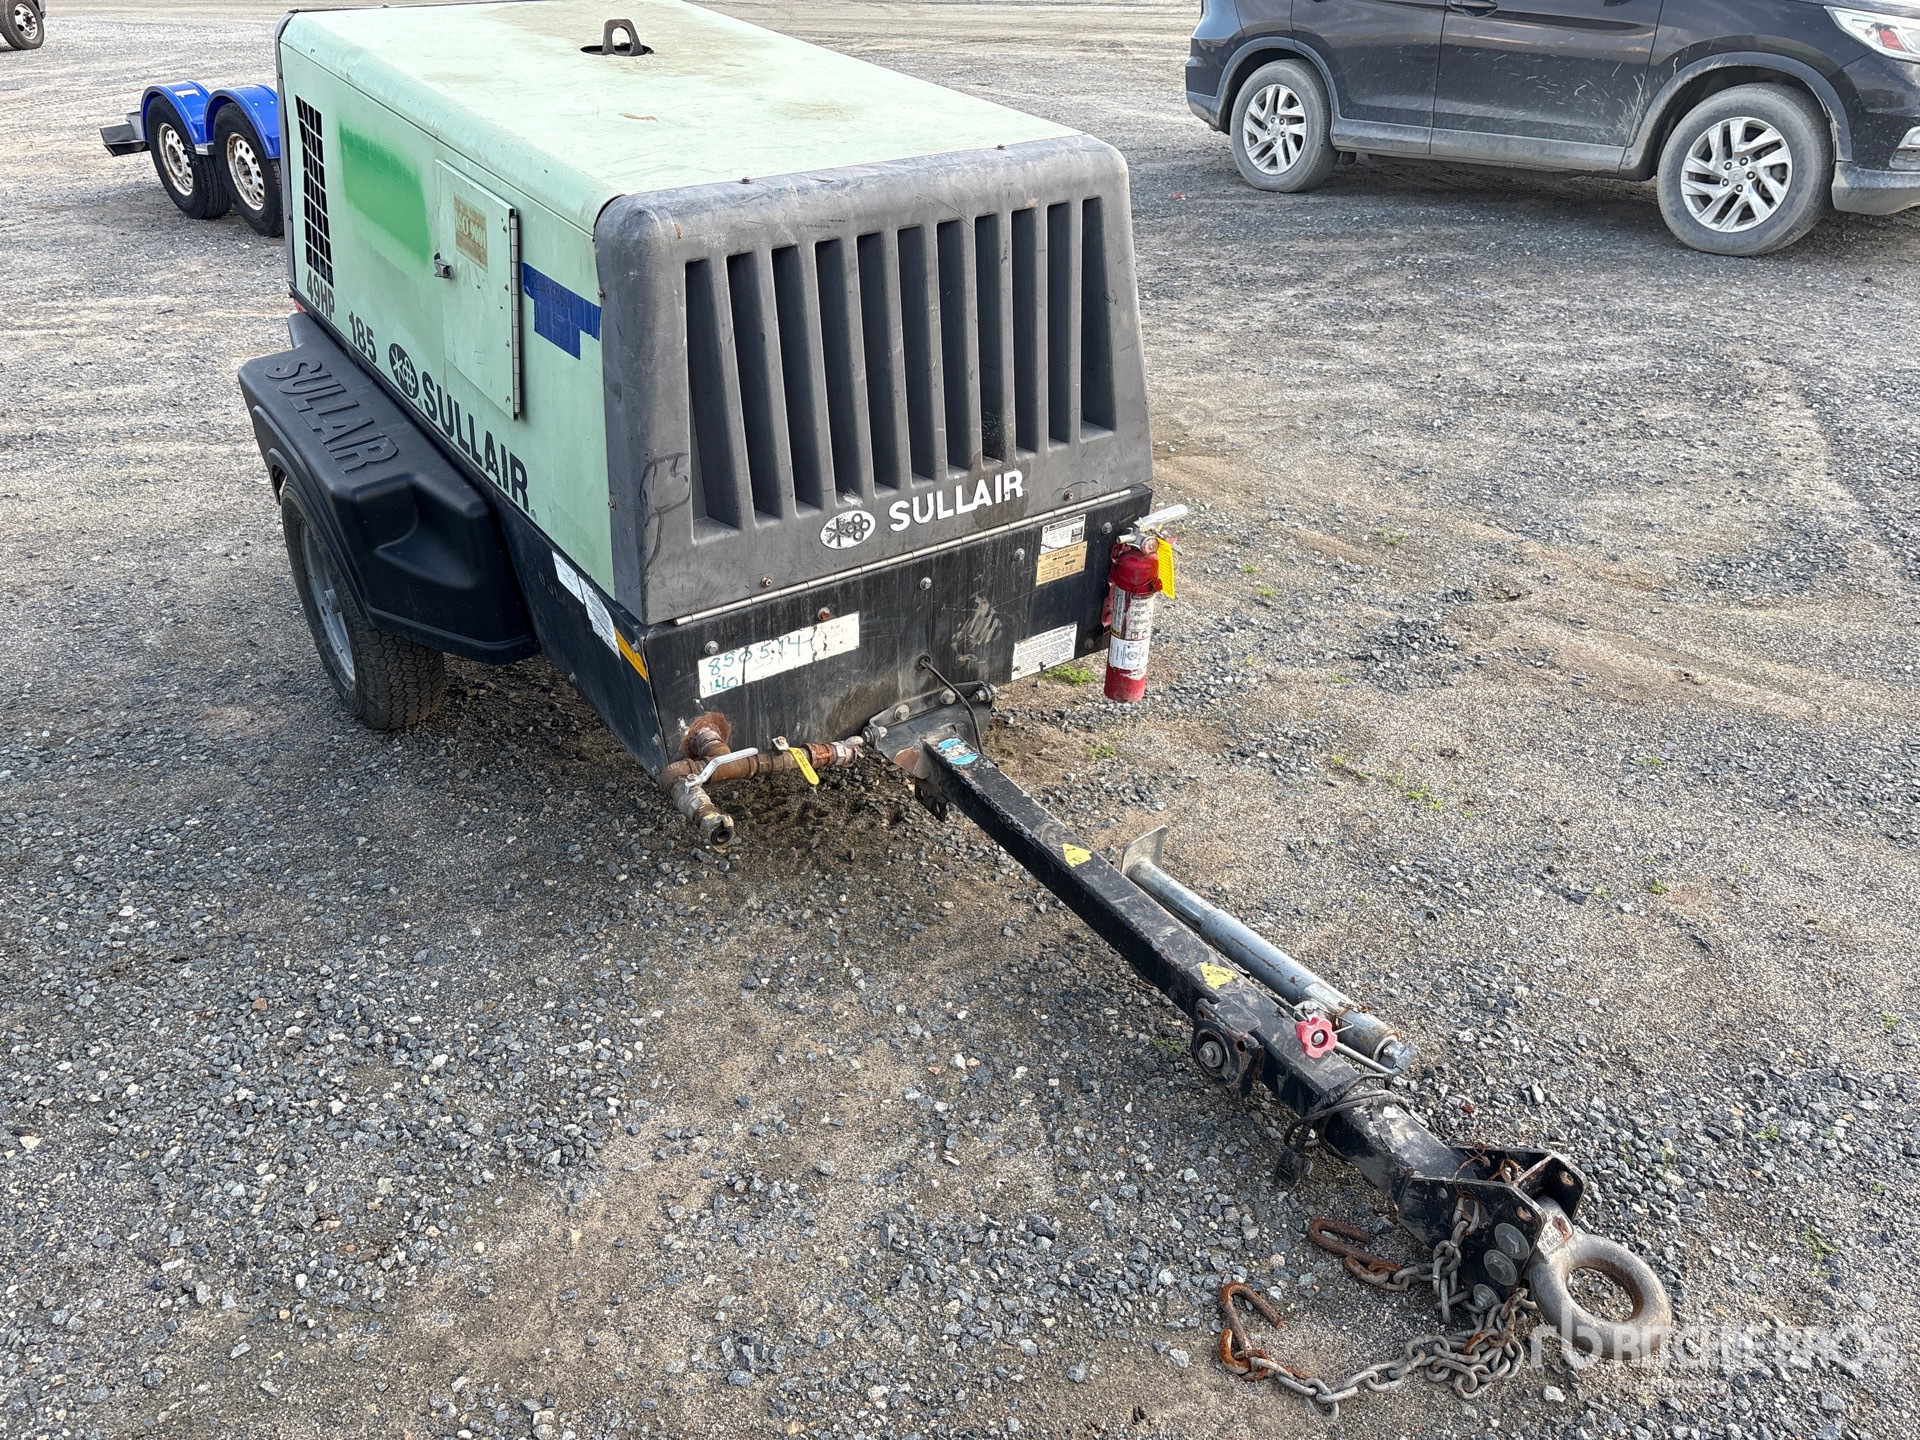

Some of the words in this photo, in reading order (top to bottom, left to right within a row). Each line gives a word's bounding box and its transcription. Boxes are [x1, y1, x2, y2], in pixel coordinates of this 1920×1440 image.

[306, 269, 335, 323] 49HP
[348, 310, 377, 364] 185
[264, 357, 400, 474] SULLAIR
[421, 370, 530, 514] SULLAIR
[888, 469, 1024, 532] SULLAIR
